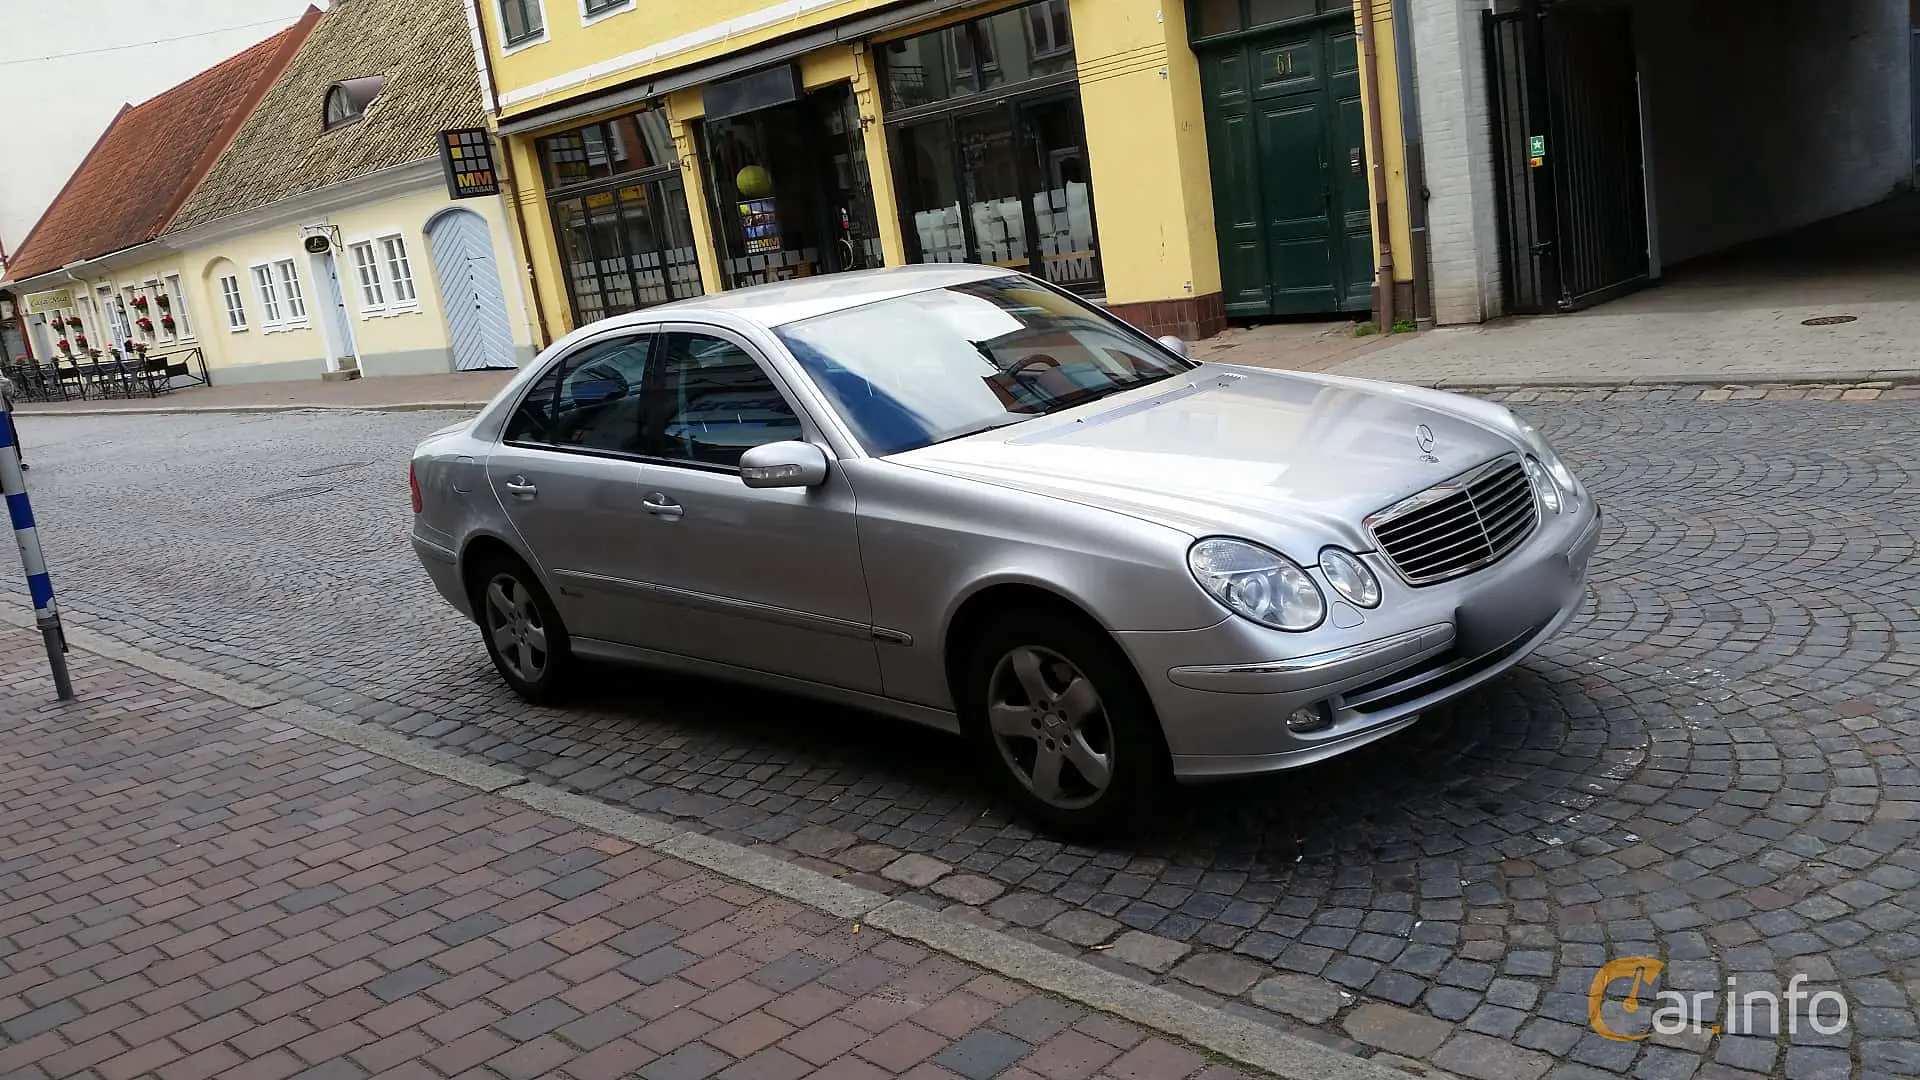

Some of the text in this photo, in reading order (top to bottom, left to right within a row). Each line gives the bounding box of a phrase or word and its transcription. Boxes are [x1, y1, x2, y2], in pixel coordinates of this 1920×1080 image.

[1276, 52, 1292, 75] 61
[457, 170, 493, 187] MM
[758, 237, 780, 248] MM
[1044, 257, 1093, 281] MM
